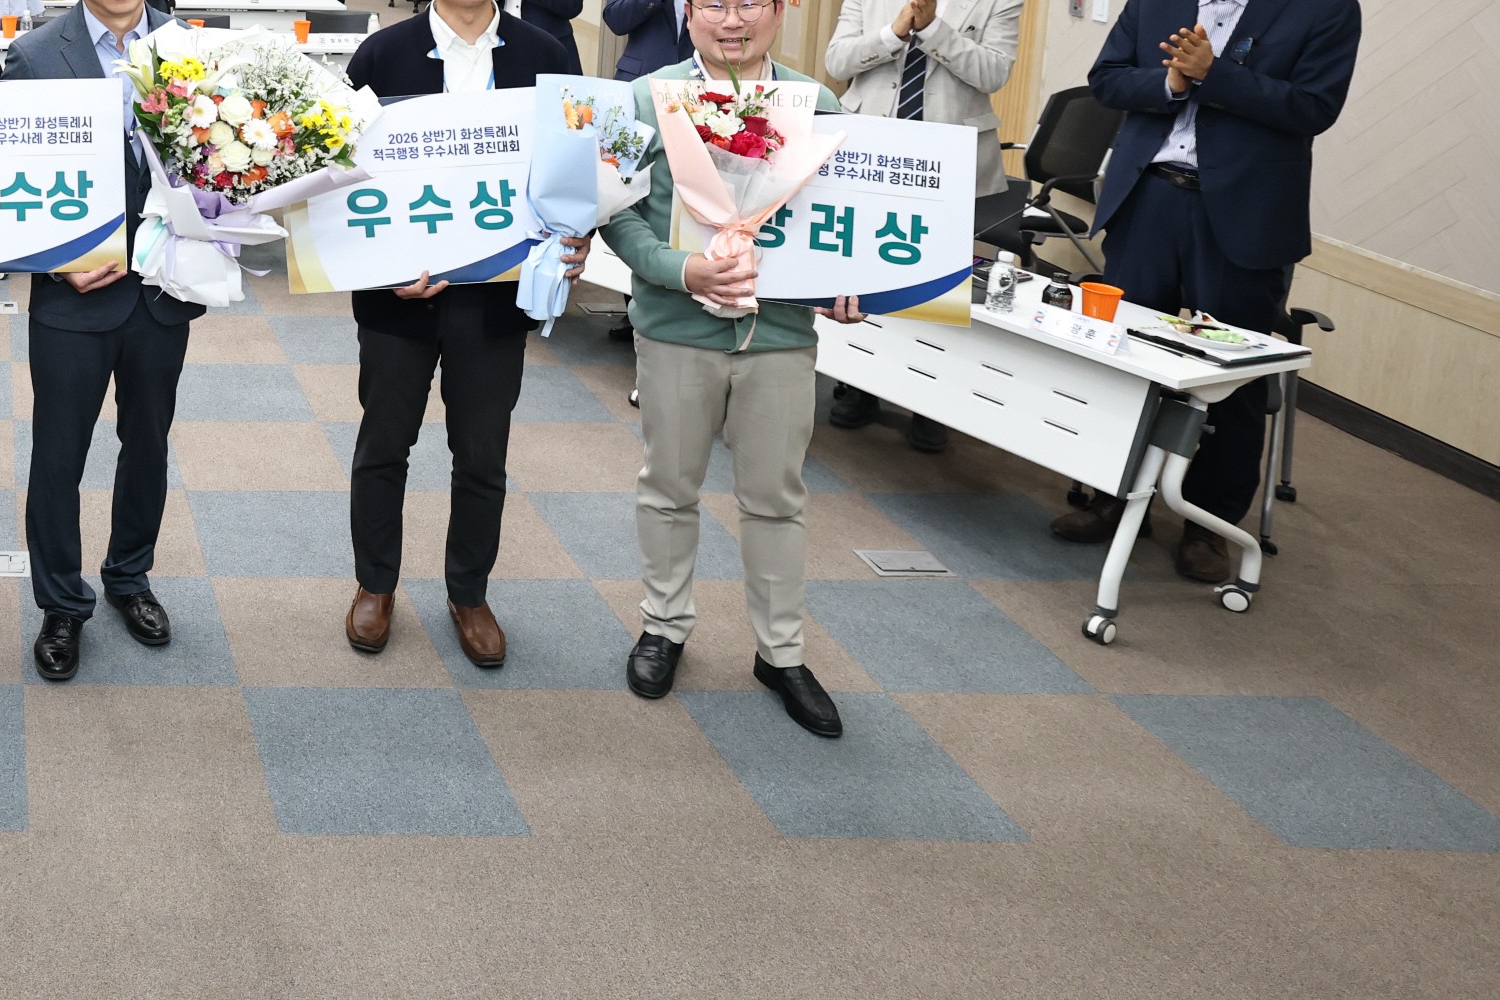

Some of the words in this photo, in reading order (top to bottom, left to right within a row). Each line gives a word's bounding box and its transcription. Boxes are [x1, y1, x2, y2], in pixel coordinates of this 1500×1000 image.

[34, 116, 92, 129] 화성특례시
[46, 131, 93, 144] 경진대회
[388, 132, 418, 145] 2026
[421, 129, 457, 143] 상반기
[460, 125, 519, 140] 화성특례시
[373, 146, 419, 161] 적극행정
[423, 143, 470, 158] 우수사례
[473, 140, 520, 155] 경진대회
[834, 149, 872, 165] 상반기
[877, 154, 941, 174] 화성특례시
[834, 165, 884, 183] 우수사례
[888, 171, 941, 189] 경진대회
[346, 178, 517, 238] 우수상
